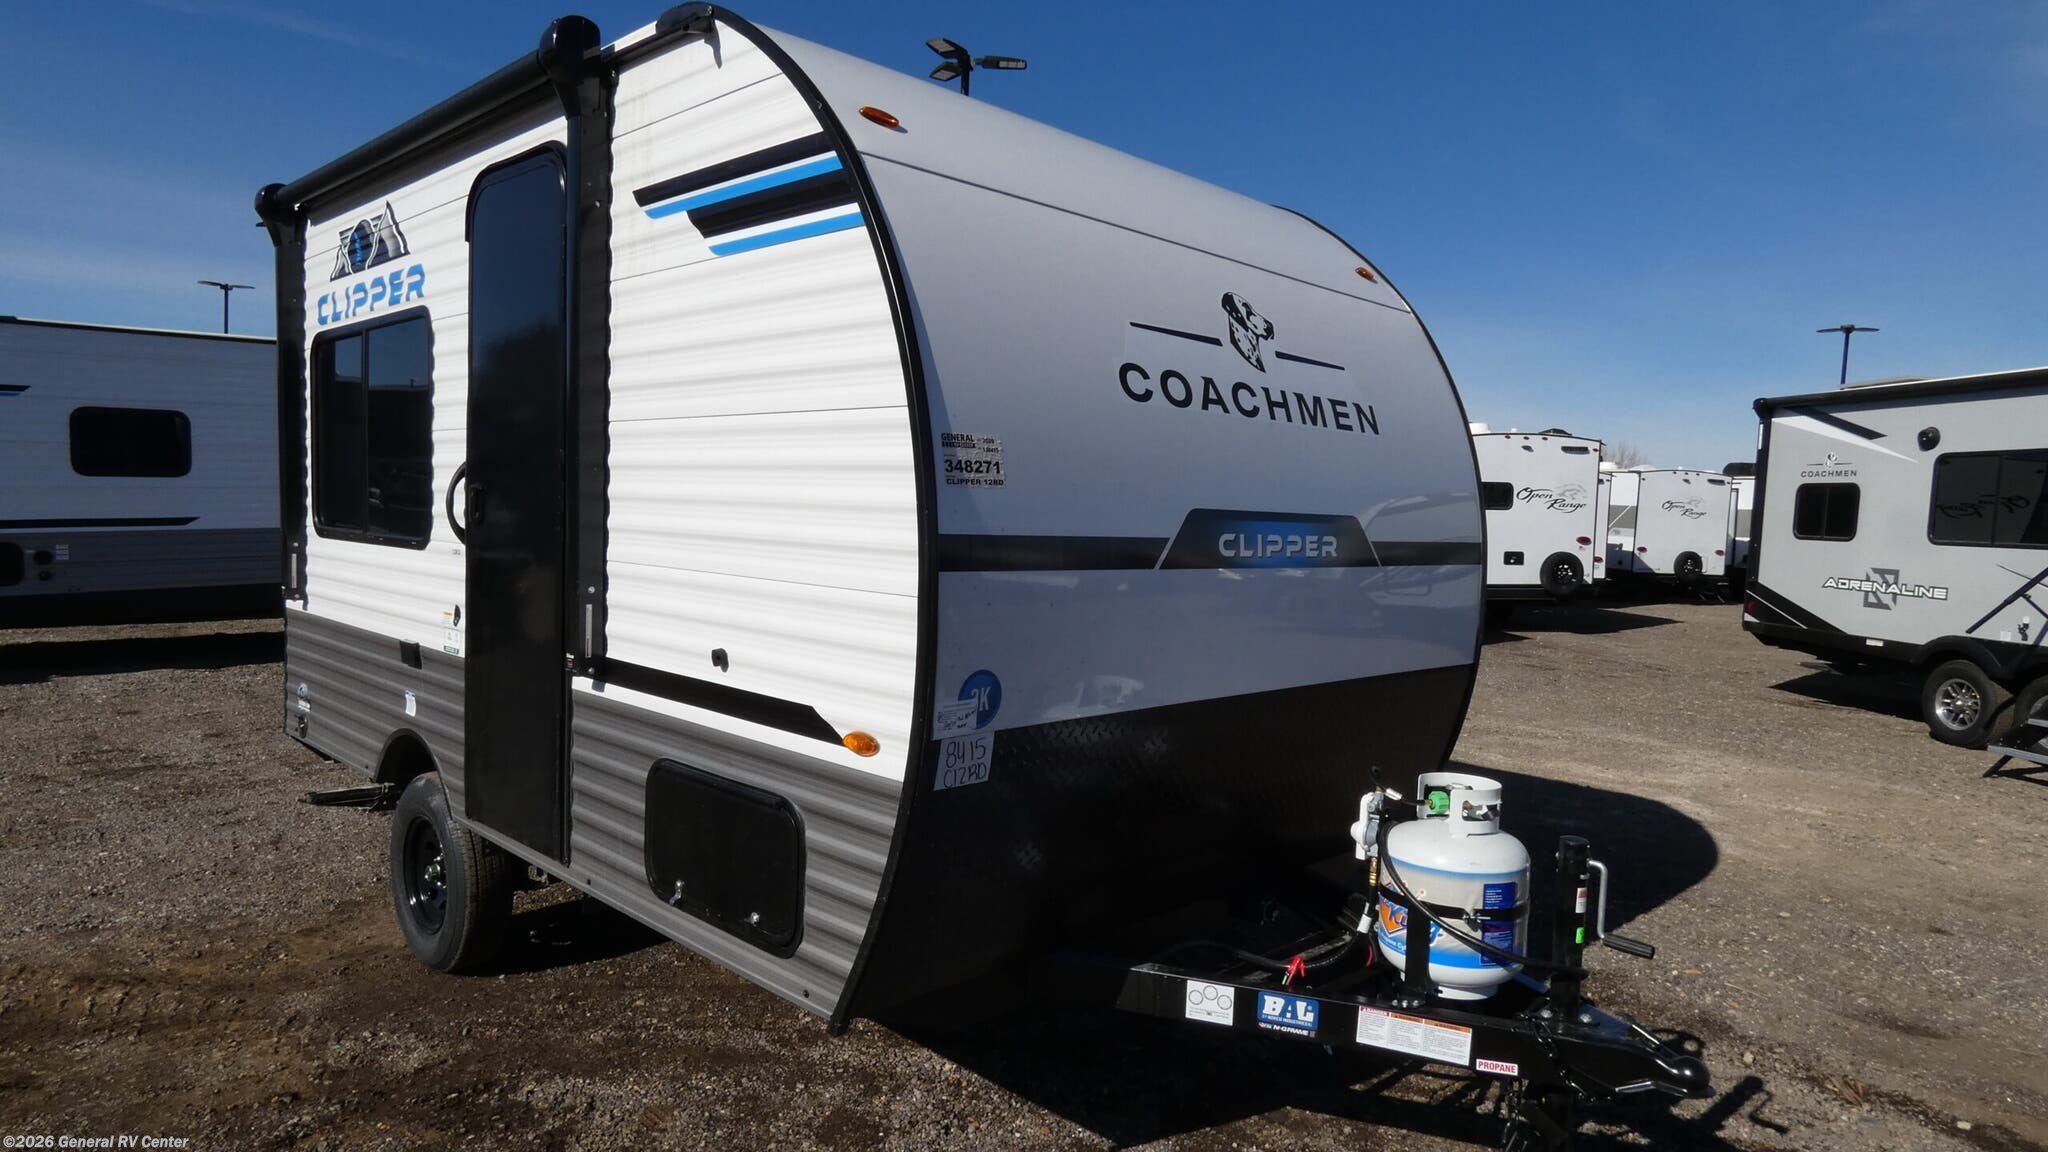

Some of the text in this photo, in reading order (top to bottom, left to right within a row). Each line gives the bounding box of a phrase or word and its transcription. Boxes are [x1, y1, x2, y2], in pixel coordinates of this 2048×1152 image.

[317, 263, 426, 325] CLIPPER
[1119, 362, 1379, 435] COACHMEN
[941, 433, 974, 442] GENERAL
[944, 459, 1000, 474] 348271
[1800, 470, 1858, 478] COACHMEN
[1516, 486, 1554, 504] Open
[1544, 498, 1587, 513] Range
[1661, 500, 1686, 512] Open
[1680, 508, 1708, 520] Range
[1218, 533, 1338, 557] CLIPPER
[1822, 576, 1949, 600] ADRENALINE
[945, 737, 986, 768] 8415
[1478, 1060, 1517, 1073] PROPANE
